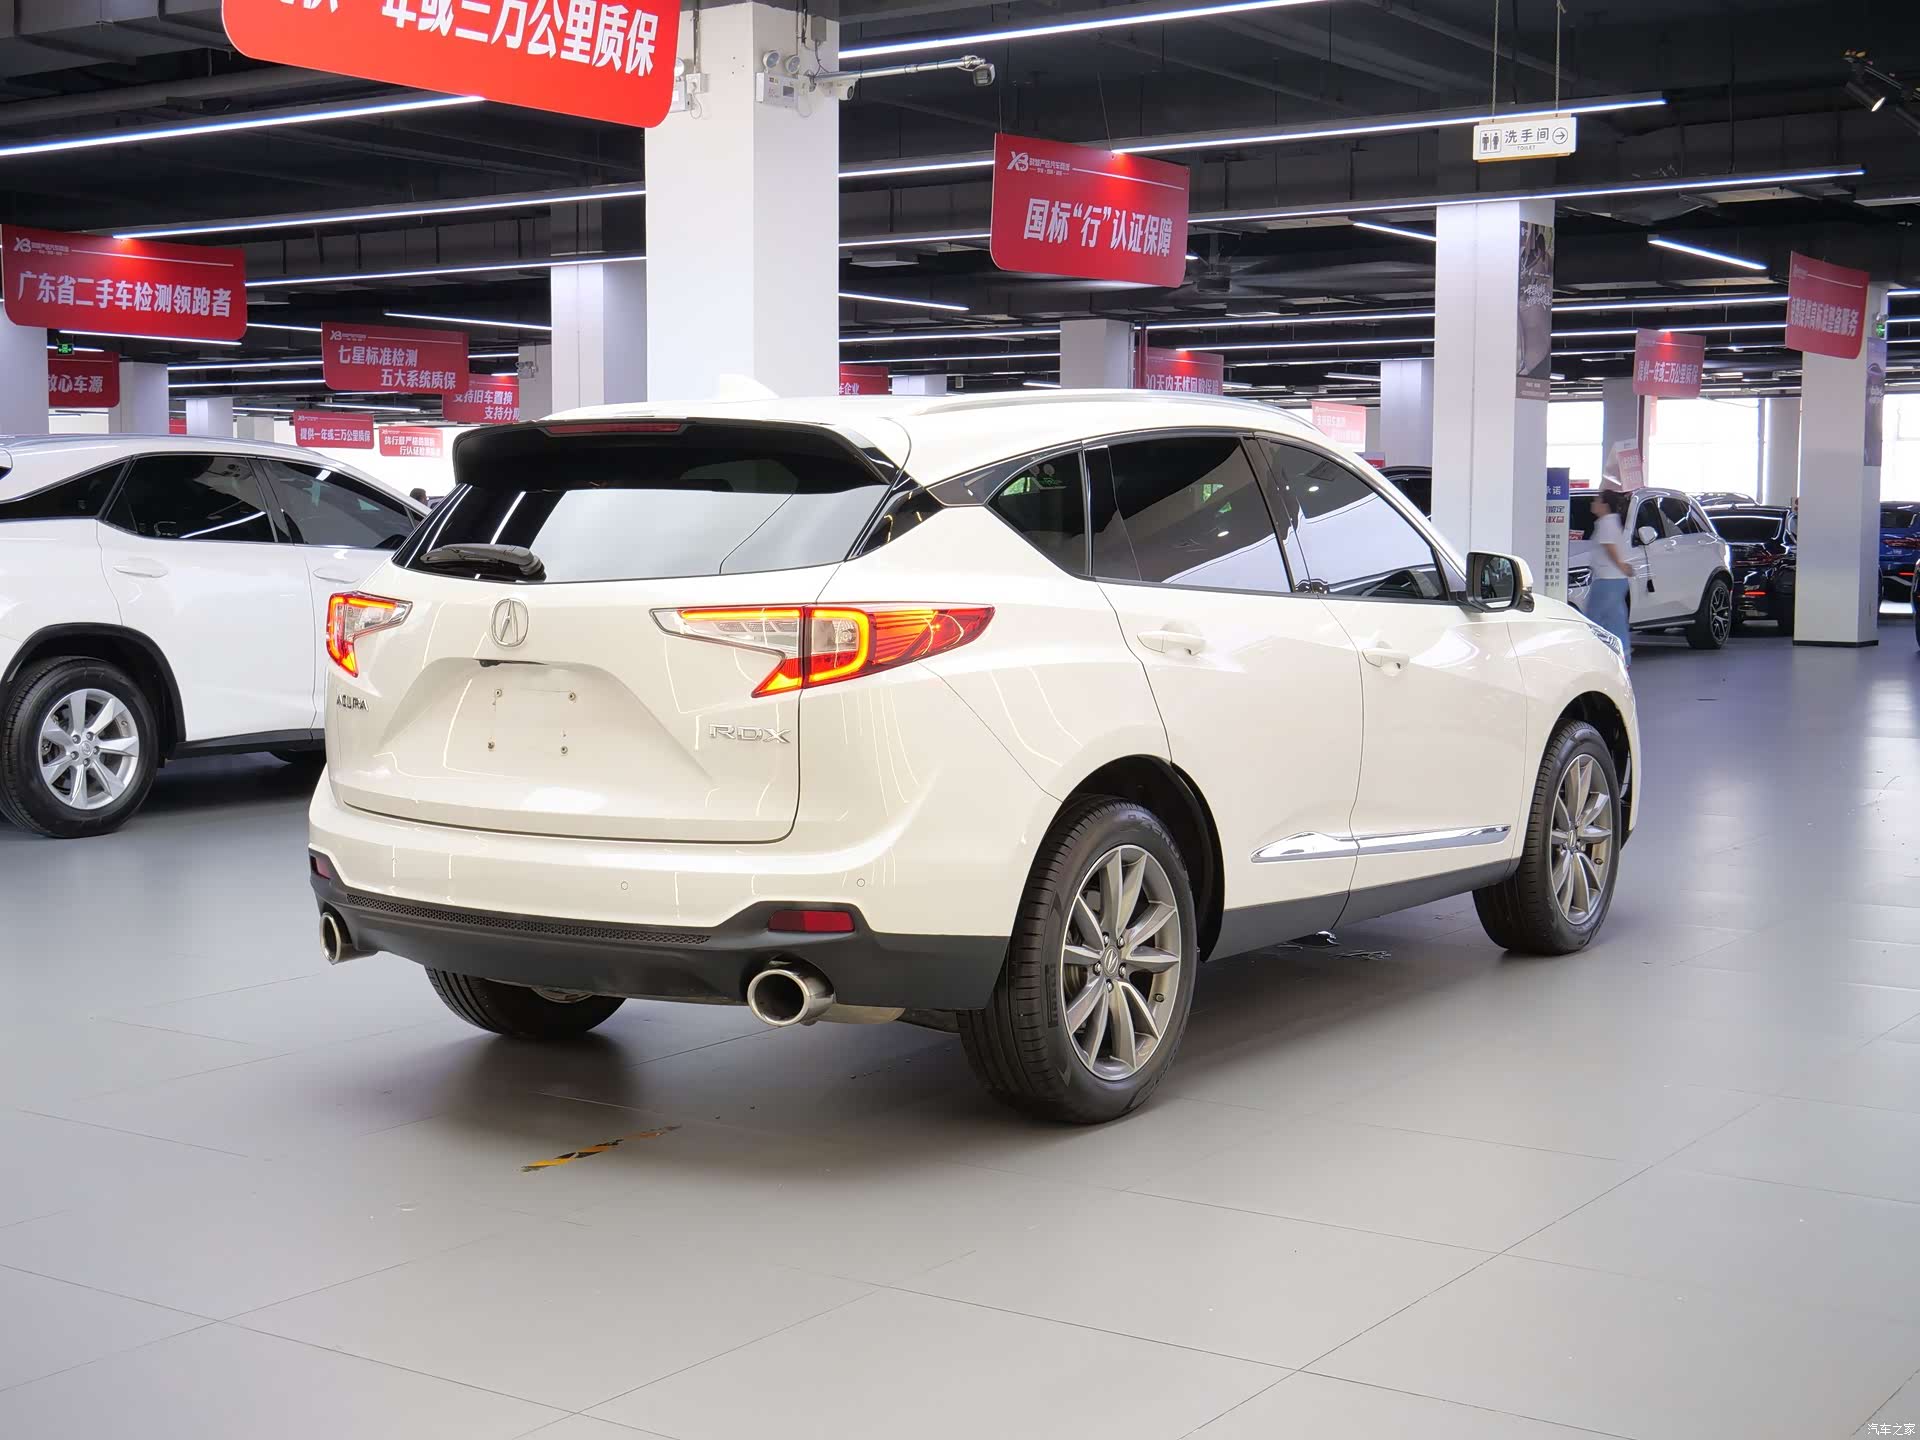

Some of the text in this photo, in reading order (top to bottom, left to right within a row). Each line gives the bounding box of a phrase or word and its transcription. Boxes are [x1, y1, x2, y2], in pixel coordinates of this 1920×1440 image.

[279, 0, 660, 77] 年或三万公里质保
[1504, 127, 1550, 144] 洗手间
[18, 270, 232, 318] 广东省二手车检测领跑者
[338, 345, 419, 368] 七星标准检测
[380, 368, 457, 390] 五大系统质保
[336, 694, 369, 711] ACURA
[709, 723, 791, 744] RDX
